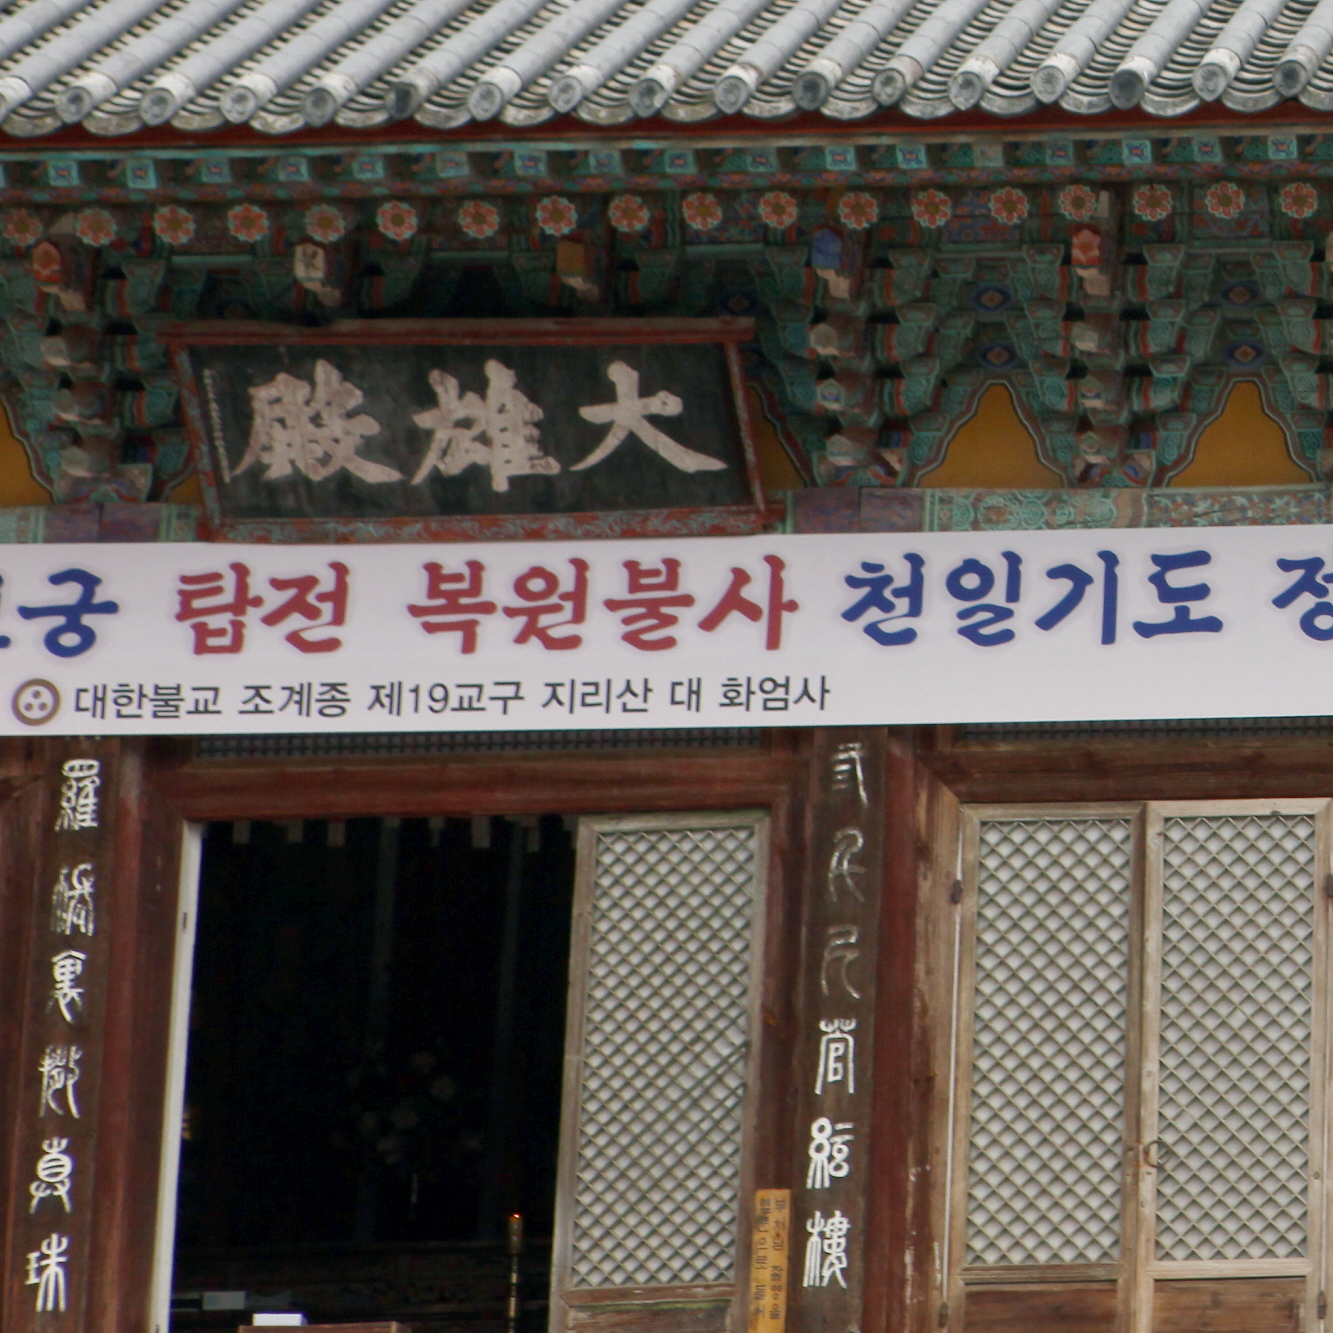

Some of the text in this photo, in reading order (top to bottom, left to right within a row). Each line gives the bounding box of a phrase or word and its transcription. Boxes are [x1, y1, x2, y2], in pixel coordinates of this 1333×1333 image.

[0, 568, 119, 658] 궁
[175, 562, 350, 655] 탑전
[407, 555, 799, 654] 복원불사
[841, 550, 1223, 647] 천일기도
[75, 675, 831, 720] 대한불교 조계종 제19교구 지리산 대 화엄사
